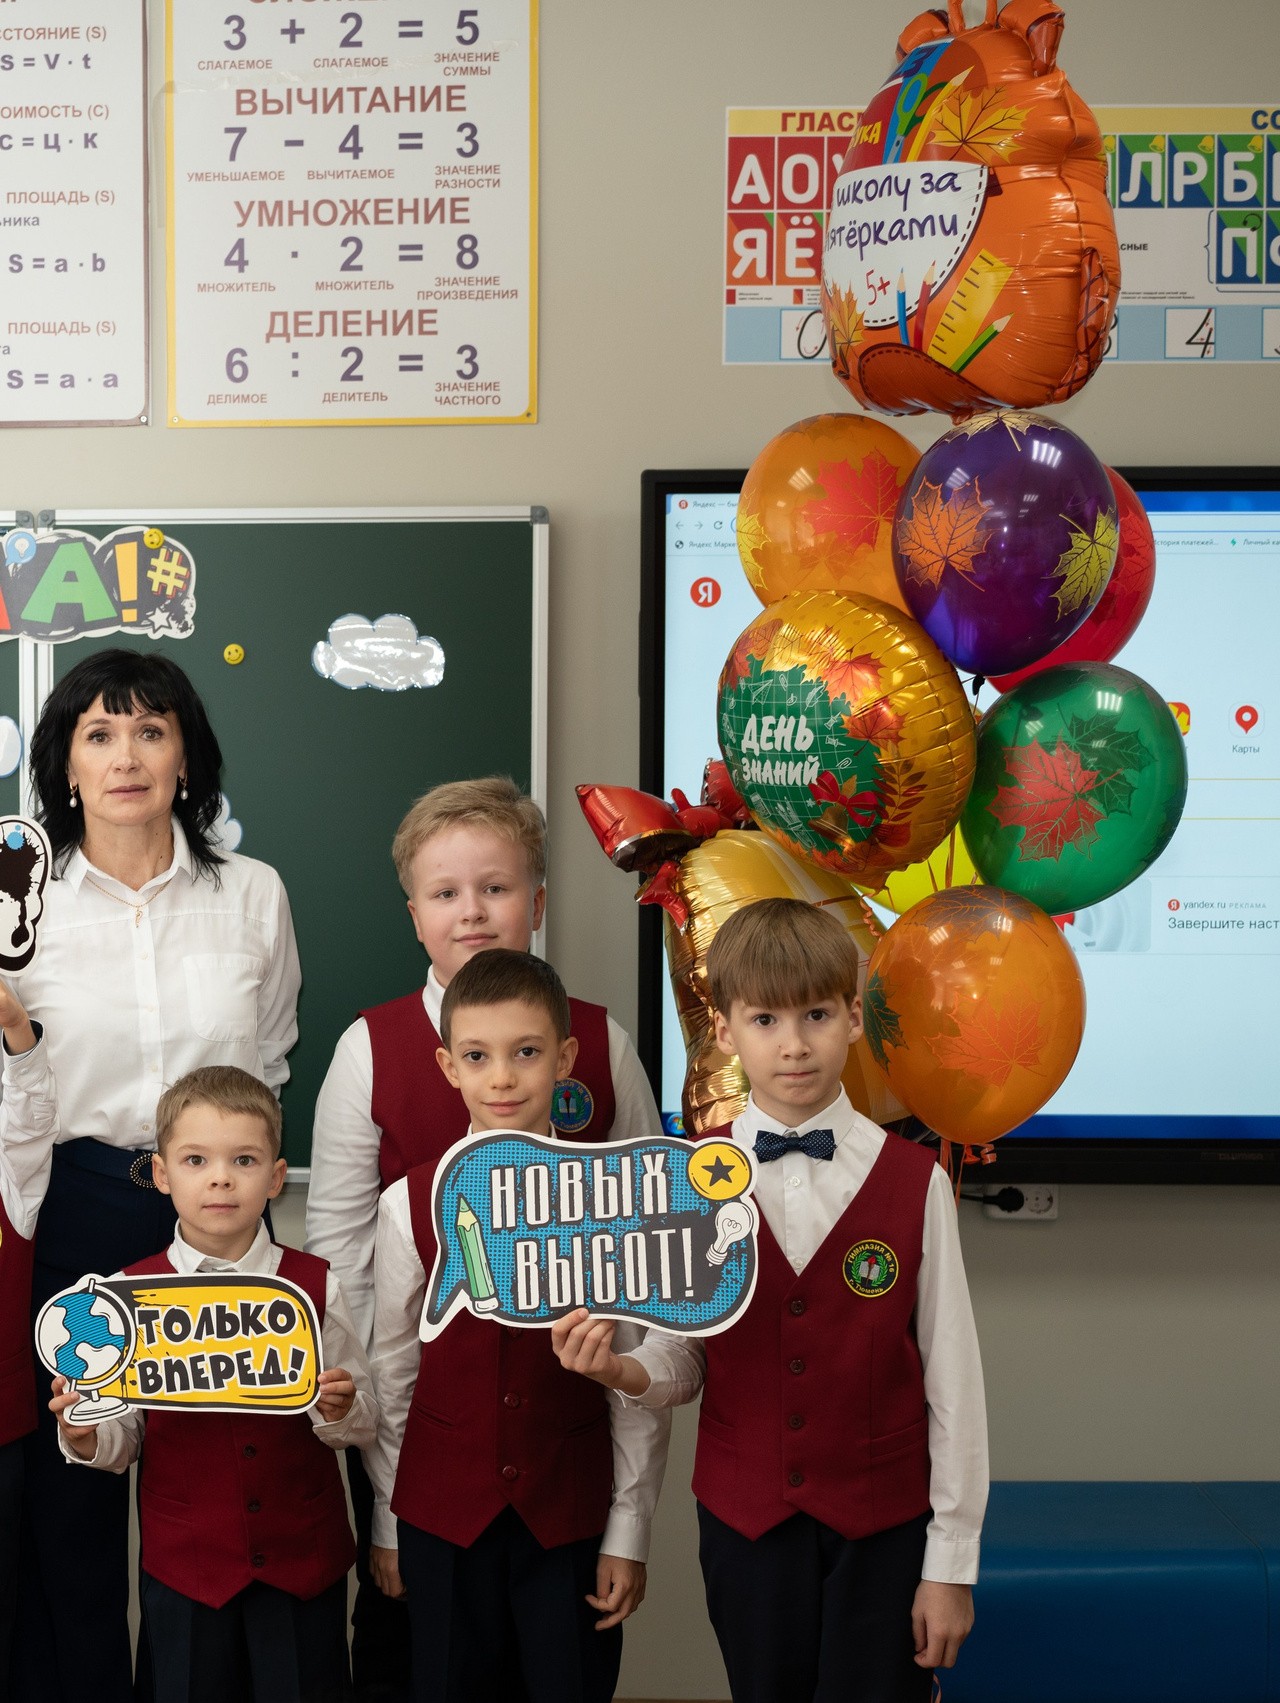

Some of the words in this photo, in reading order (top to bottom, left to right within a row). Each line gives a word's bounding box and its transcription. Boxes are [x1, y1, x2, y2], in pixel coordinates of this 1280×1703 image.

[86, 26, 106, 42] (S)
[224, 15, 246, 50] 3
[281, 19, 305, 44] +
[340, 12, 362, 48] 2
[399, 21, 423, 38] =
[456, 10, 479, 45] 5
[198, 59, 272, 70] СЛАГАЕМОЕ
[313, 57, 388, 68] СЛАГАЕМОЕ
[434, 52, 499, 63] ЗНАЧЕНИЕ
[443, 66, 490, 76] СУММЫ
[236, 85, 466, 115] ВЫЧИТАНИЕ
[88, 105, 109, 120] (С)
[224, 127, 247, 161] 7
[339, 125, 363, 160] 4
[399, 133, 423, 150] =
[456, 122, 479, 158] 3
[187, 171, 284, 182] УМЕНЬШАЕМОЕ
[308, 169, 394, 180] ВЫЧИТАЕМОЕ
[435, 165, 500, 175] ЗНАЧЕНИЕ
[1120, 152, 1162, 202] Л
[1173, 152, 1208, 202] Р
[1223, 152, 1257, 202] Б
[435, 179, 500, 188] РАЗНОСТИ
[731, 154, 770, 204] А
[782, 154, 819, 204] О
[7, 191, 89, 205] ПЛОЩАДЬ
[95, 190, 115, 205] (S)
[837, 175, 911, 212] школу
[920, 172, 962, 194] за
[234, 197, 470, 227] УМНОЖЕНИЕ
[224, 238, 249, 273] 4
[340, 236, 363, 271] 2
[399, 244, 423, 261] =
[456, 234, 479, 270] 8
[732, 228, 767, 278] Я
[785, 216, 816, 278] Ё
[1120, 243, 1149, 251] СНЫЕ
[1222, 228, 1257, 278] П
[198, 282, 276, 292] МНОЖИТЕЛЬ
[316, 280, 394, 290] МНОЖИТЕЛЬ
[435, 276, 500, 286] ЗНАЧЕНИЕ
[866, 269, 890, 306] 5+
[417, 289, 518, 301] ПРОИЗВЕДЕНИЯ
[8, 322, 91, 336] ПЛОЩАДЬ
[96, 321, 116, 336] (S)
[266, 309, 438, 343] ДЕЛЕНИЕ
[1185, 308, 1215, 358] 4
[226, 348, 248, 383] 6
[340, 347, 363, 381] 2
[399, 355, 423, 371] =
[456, 344, 480, 380] 3
[435, 382, 500, 392] ЗНАЧЕНИЕ
[207, 394, 267, 405] ДЕЛИМОЕ
[322, 392, 388, 403] ДЕЛИТЕЛЬ
[435, 395, 501, 405] ЧАСТНОГО
[714, 541, 737, 549] Марке
[741, 714, 815, 754] ДЕНЬ
[1232, 745, 1260, 754] Карты
[741, 755, 821, 788] ЗНАНИЙ
[1168, 917, 1245, 932] Завершите
[490, 1152, 669, 1230] НОВЫХ
[848, 1244, 884, 1263] ГИМНАЗИЯ
[518, 1225, 696, 1312] ВЫСОТ!
[136, 1299, 297, 1346] ТОЛЬКО
[137, 1348, 307, 1395] ВПЕРЕД!
